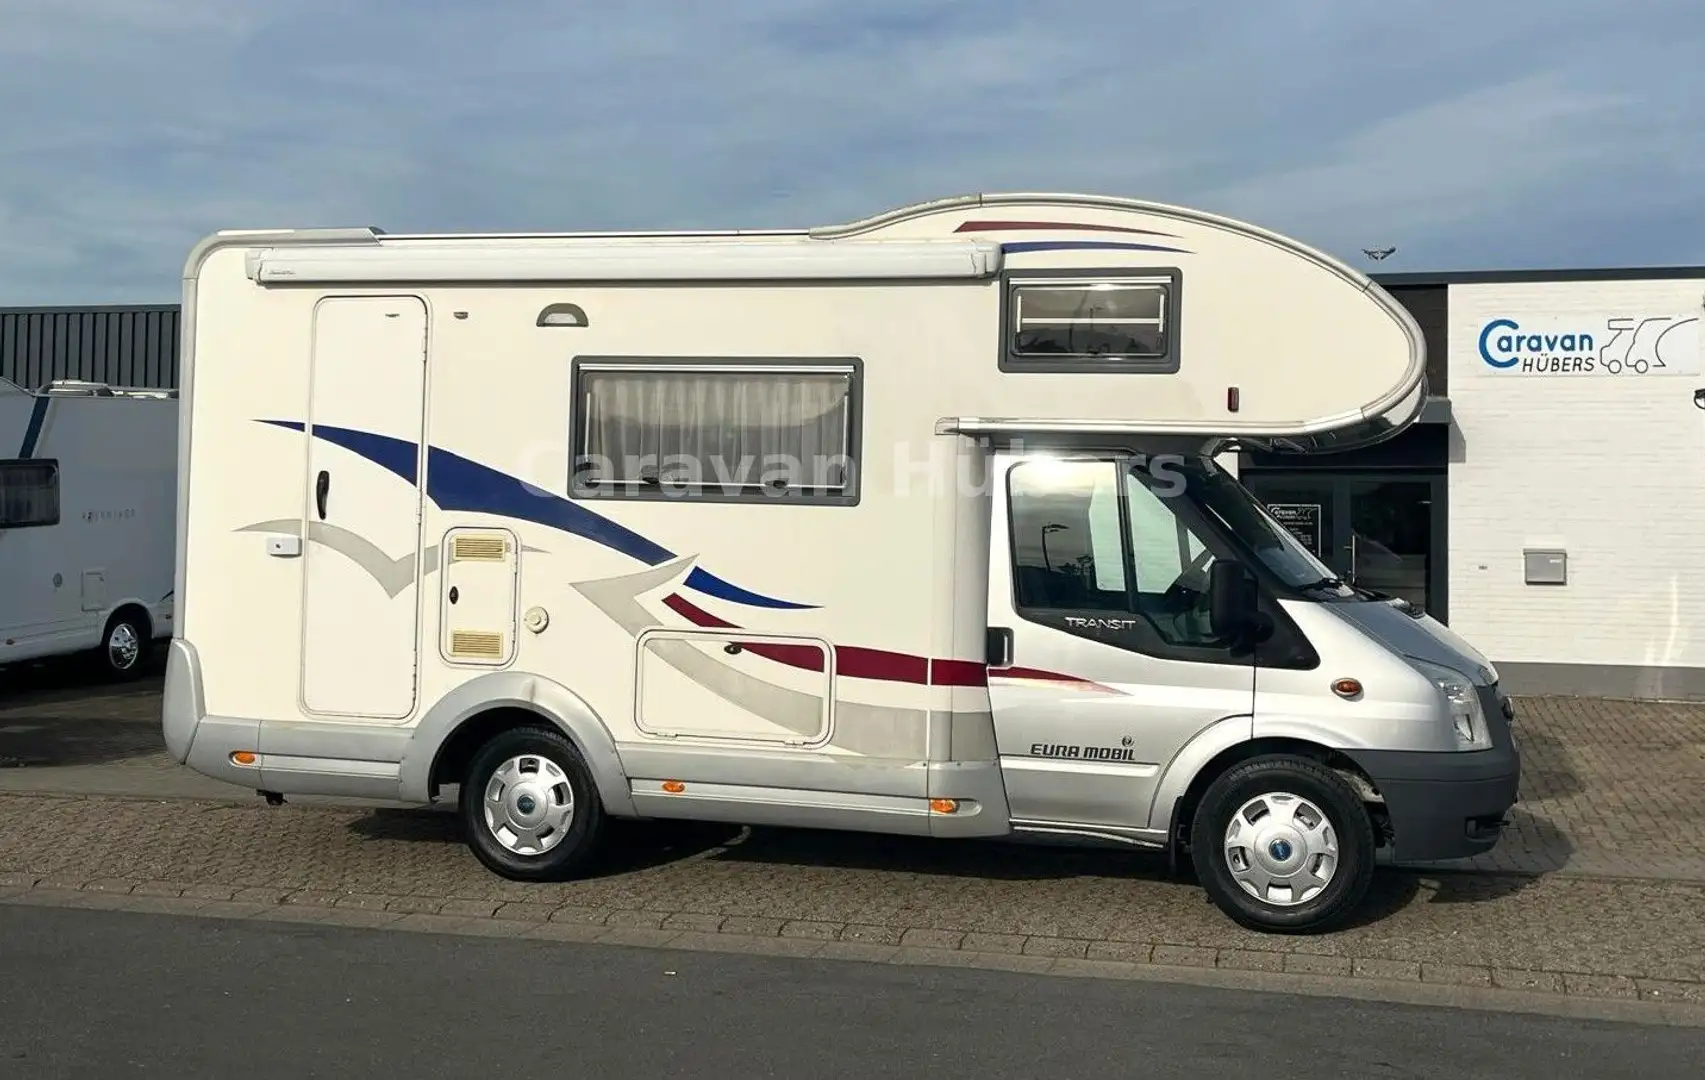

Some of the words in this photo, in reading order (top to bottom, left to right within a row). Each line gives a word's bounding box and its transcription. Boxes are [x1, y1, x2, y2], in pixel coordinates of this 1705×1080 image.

[1479, 319, 1593, 368] Caravan
[1522, 353, 1595, 372] HÜBERS
[1065, 617, 1136, 630] TRANSIT
[1030, 743, 1079, 758] EURA
[1083, 746, 1135, 761] MOBIL
